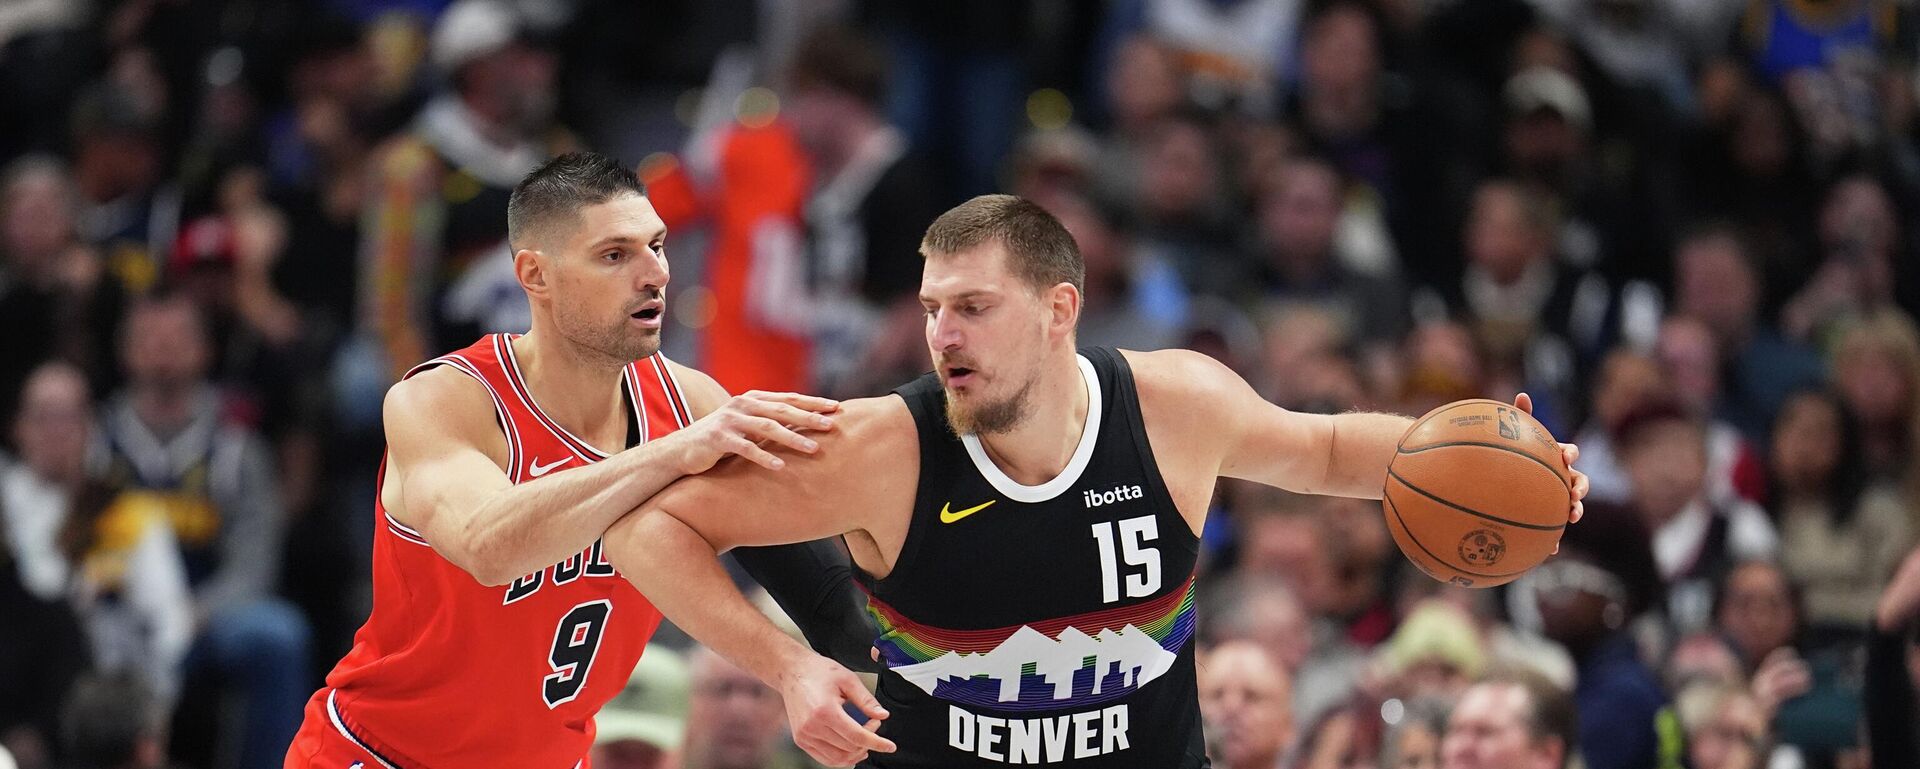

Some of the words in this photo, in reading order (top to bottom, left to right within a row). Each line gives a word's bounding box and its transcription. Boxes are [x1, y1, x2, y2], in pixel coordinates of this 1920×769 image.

[1083, 484, 1144, 509] ibotta
[1091, 514, 1162, 604] 15
[542, 598, 613, 710] 9
[949, 703, 1130, 765] DENVER
